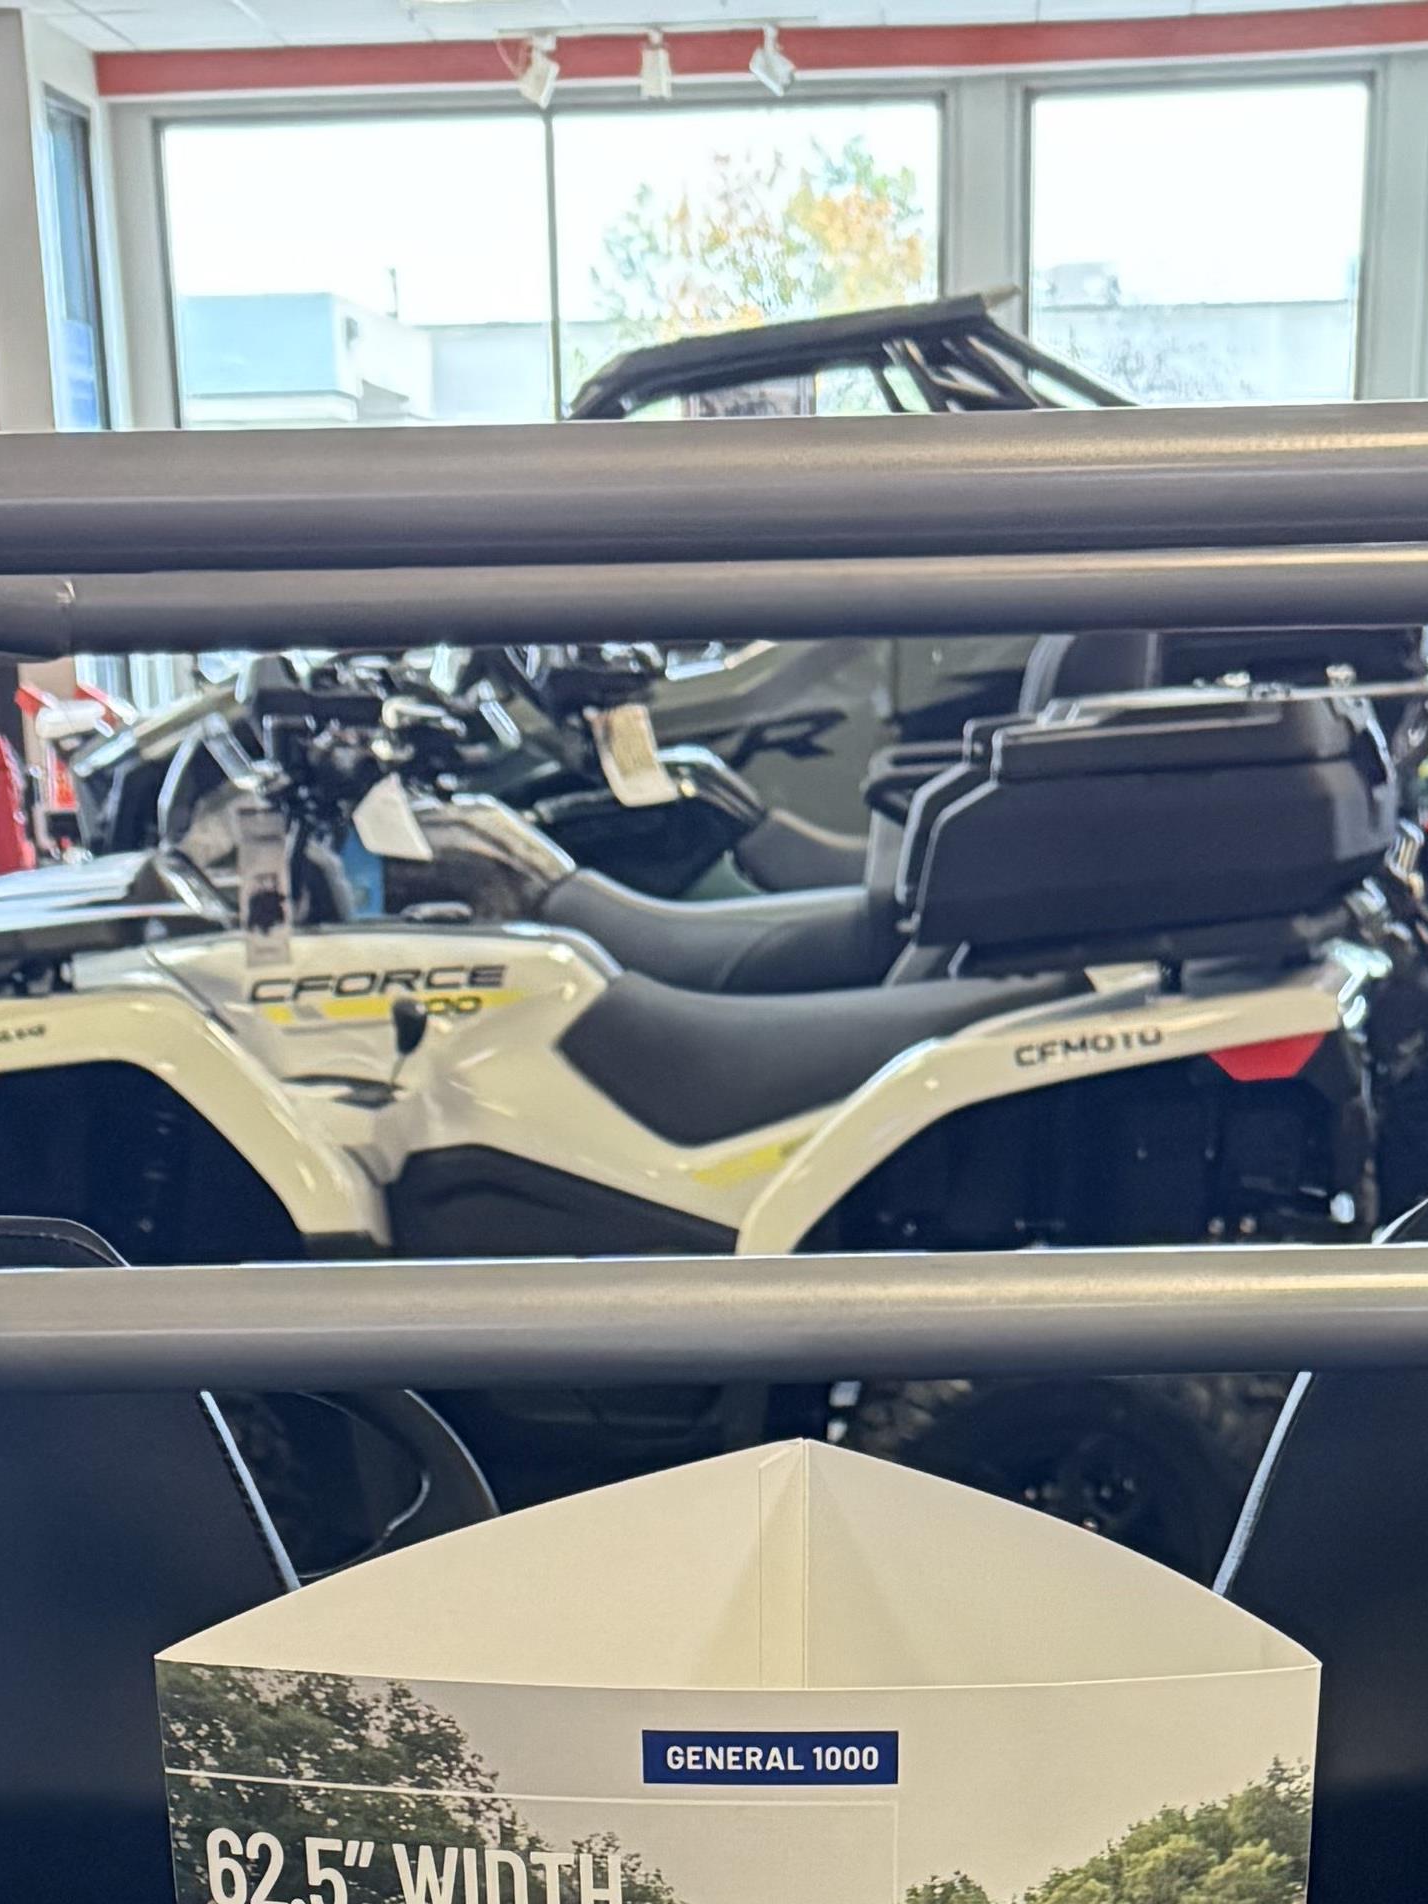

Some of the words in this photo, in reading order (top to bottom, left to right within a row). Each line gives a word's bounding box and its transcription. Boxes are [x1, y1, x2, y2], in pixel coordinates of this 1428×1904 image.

[251, 964, 507, 1004] CFORCE
[1013, 1029, 1163, 1067] CFMOTO
[666, 1745, 805, 1771] GENERAL
[812, 1746, 879, 1771] 1000
